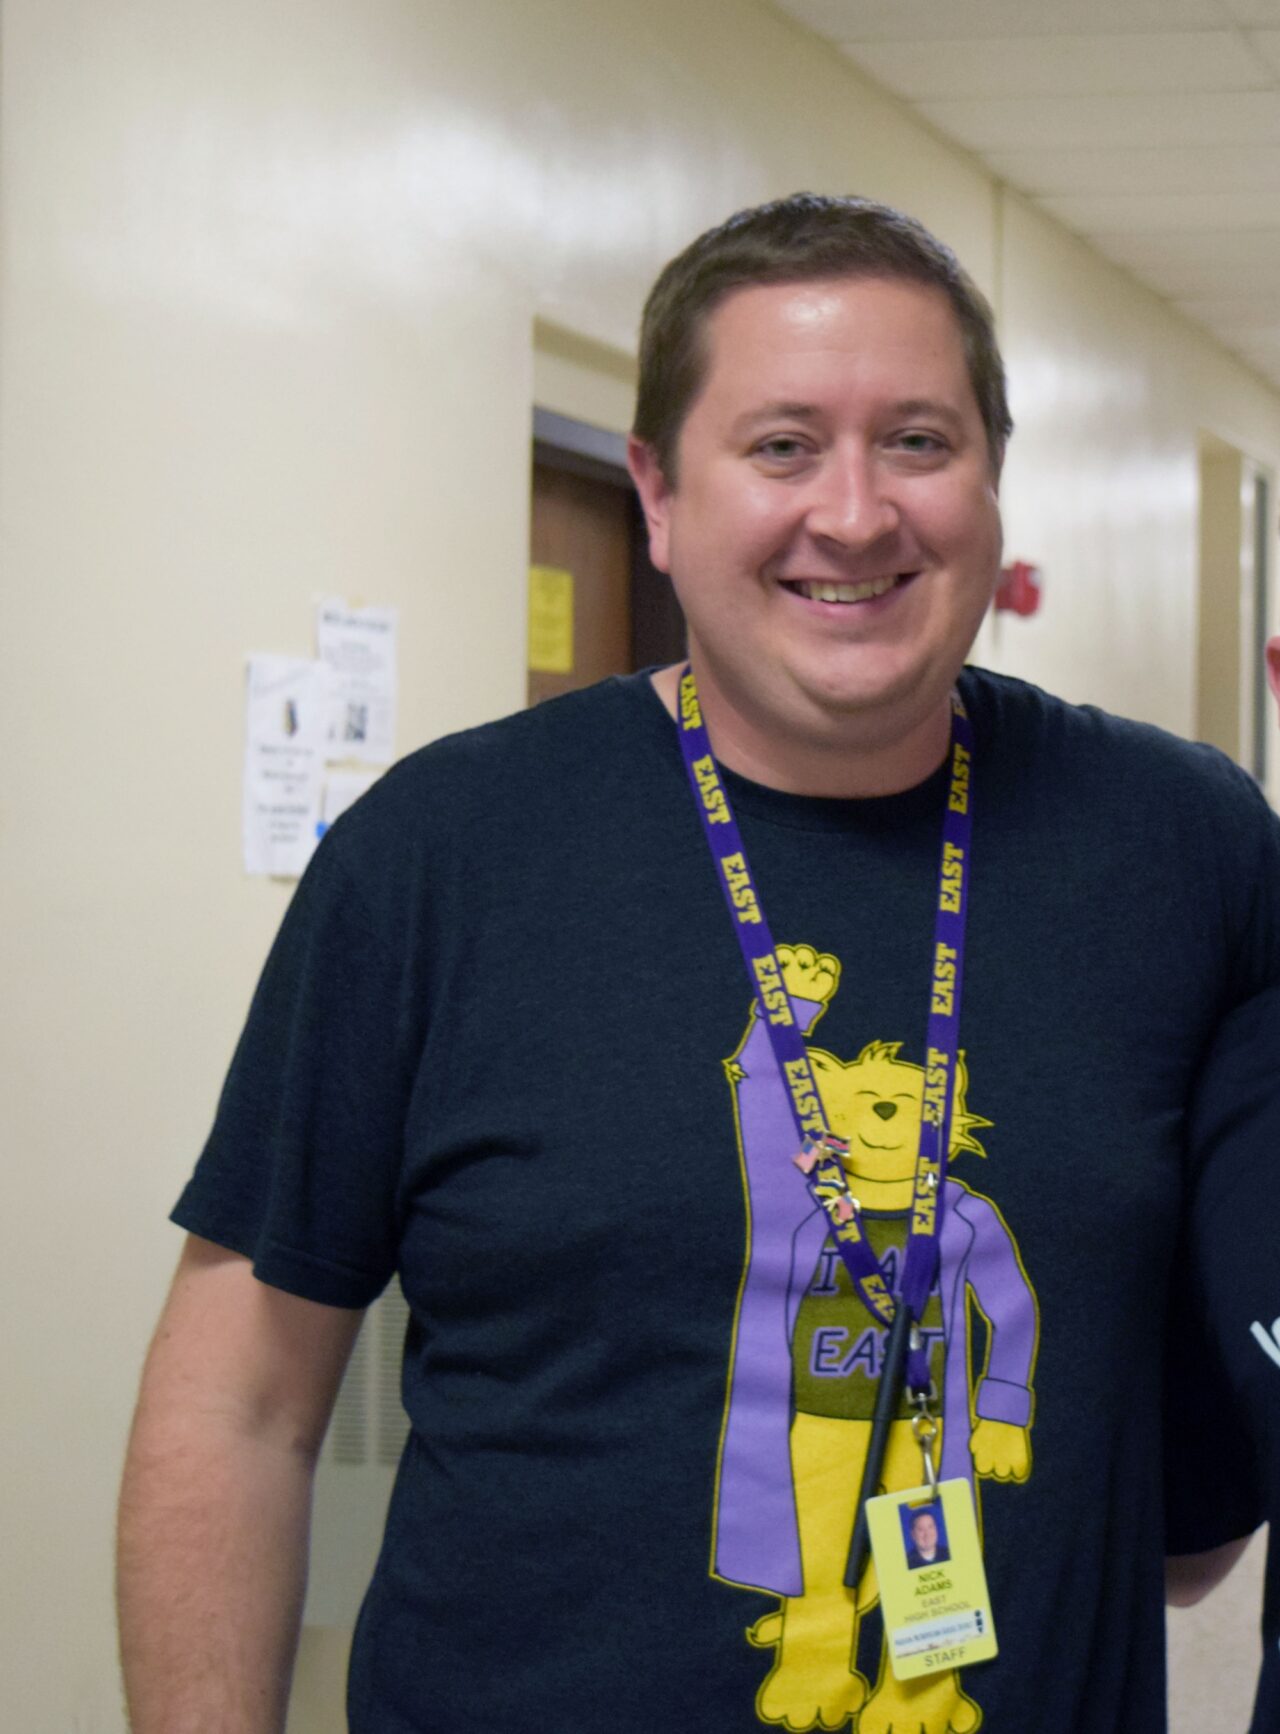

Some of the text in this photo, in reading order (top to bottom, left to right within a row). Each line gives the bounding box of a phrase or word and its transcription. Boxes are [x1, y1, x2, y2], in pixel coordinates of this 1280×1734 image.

[948, 743, 971, 815] EAST
[939, 842, 964, 914] EAST
[680, 674, 702, 730] EAST
[692, 754, 732, 825] EAST
[721, 852, 763, 924] EAST
[752, 954, 793, 1027] EAST
[784, 1058, 826, 1132] EAST
[931, 942, 958, 1017] EAST
[923, 1047, 949, 1122] EAST
[812, 1328, 945, 1377] EAT
[915, 1579, 953, 1596] ADAMS
[918, 1569, 945, 1583] NICK
[904, 1601, 971, 1623] HIGH SCHOOL
[922, 1594, 947, 1608] EAST
[925, 1646, 966, 1667] STAFF
